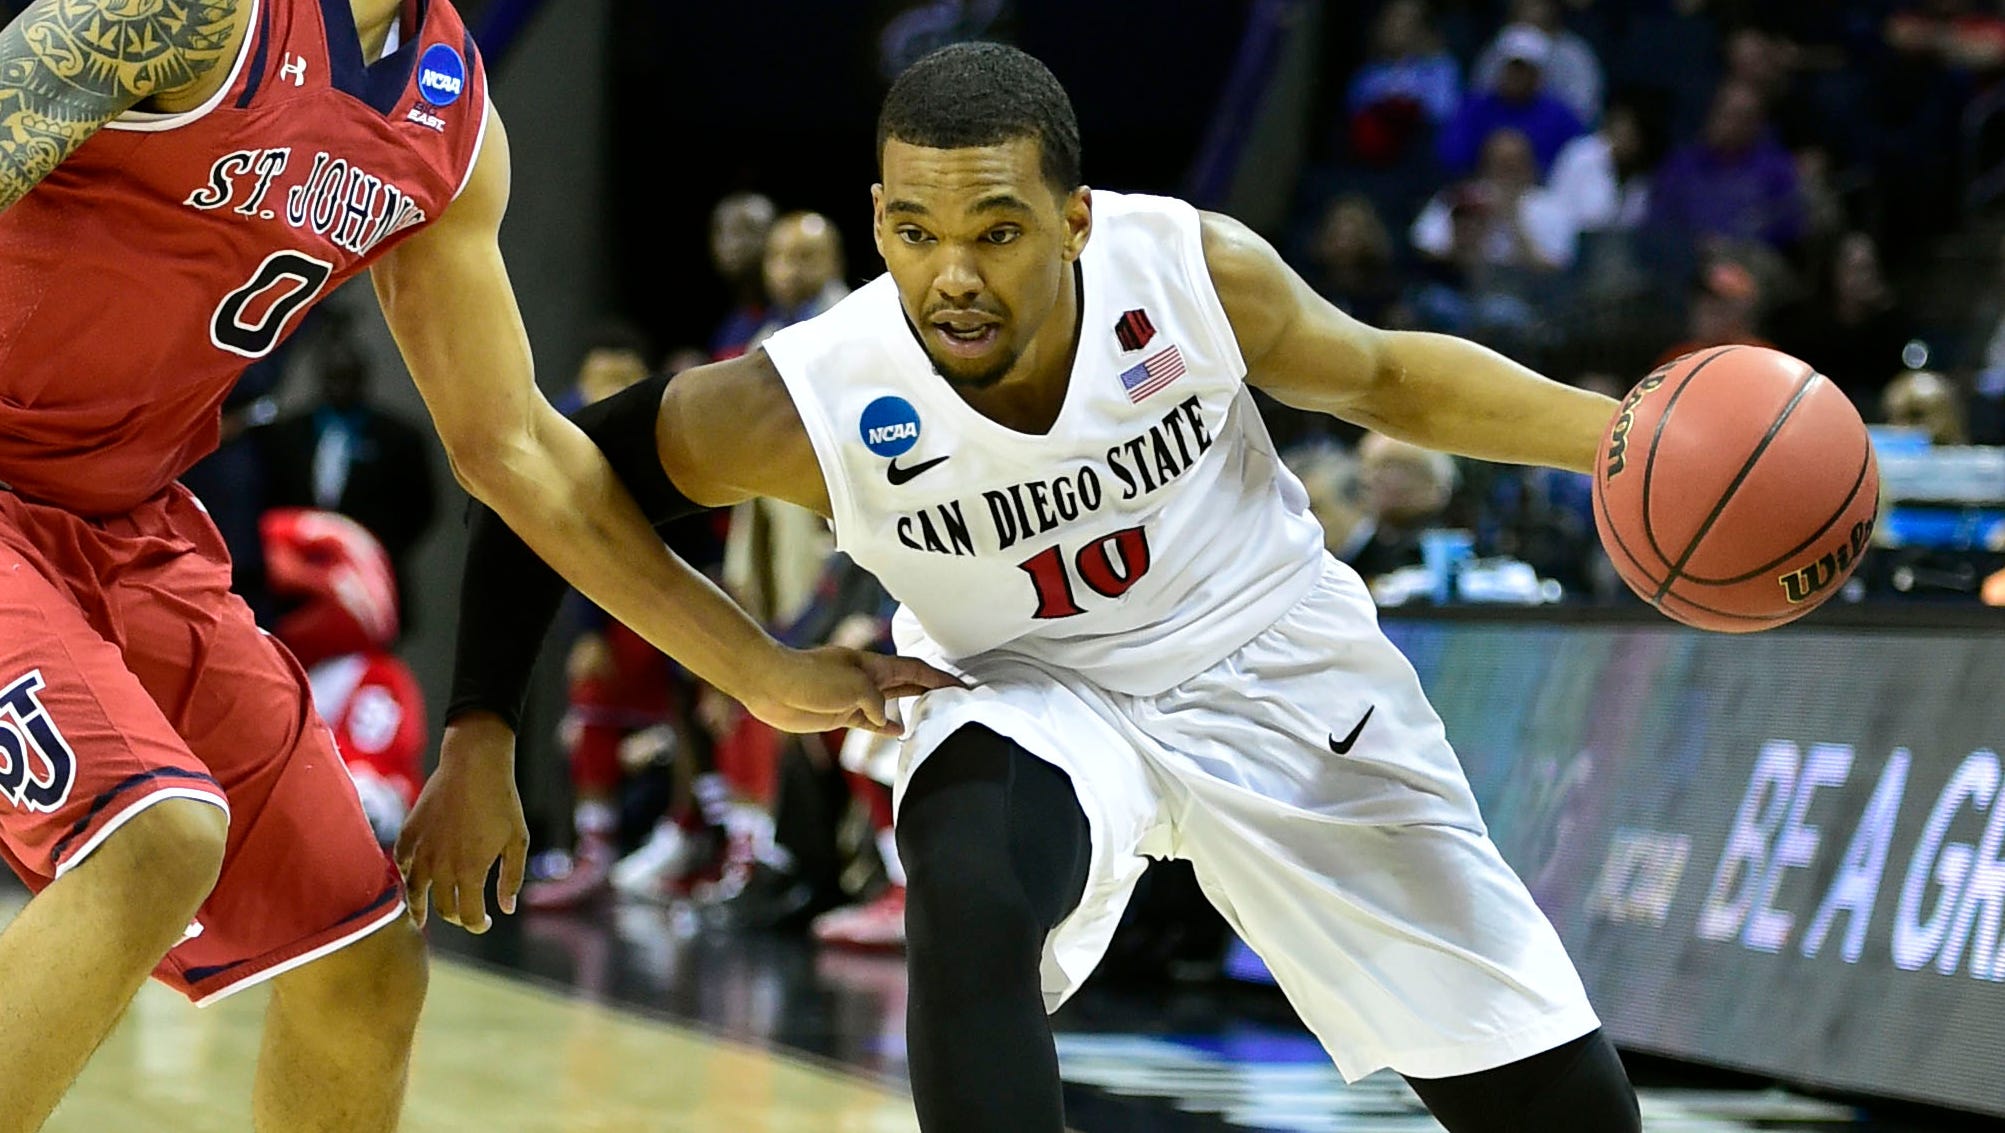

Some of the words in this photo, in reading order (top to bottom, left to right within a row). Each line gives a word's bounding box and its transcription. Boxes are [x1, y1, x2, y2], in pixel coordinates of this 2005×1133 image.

[407, 108, 446, 133] EAST
[421, 68, 461, 95] NCAA
[183, 147, 291, 220] ST.
[210, 249, 333, 358] 0
[868, 421, 918, 445] NCAA
[1606, 352, 1697, 482] lson
[896, 500, 975, 557] SAN
[982, 465, 1102, 551] DIEGO
[1106, 394, 1213, 500] STATE
[1017, 525, 1151, 619] 10
[1696, 740, 1855, 954] BE
[1800, 746, 1912, 963] A
[1890, 748, 2005, 983] GR
